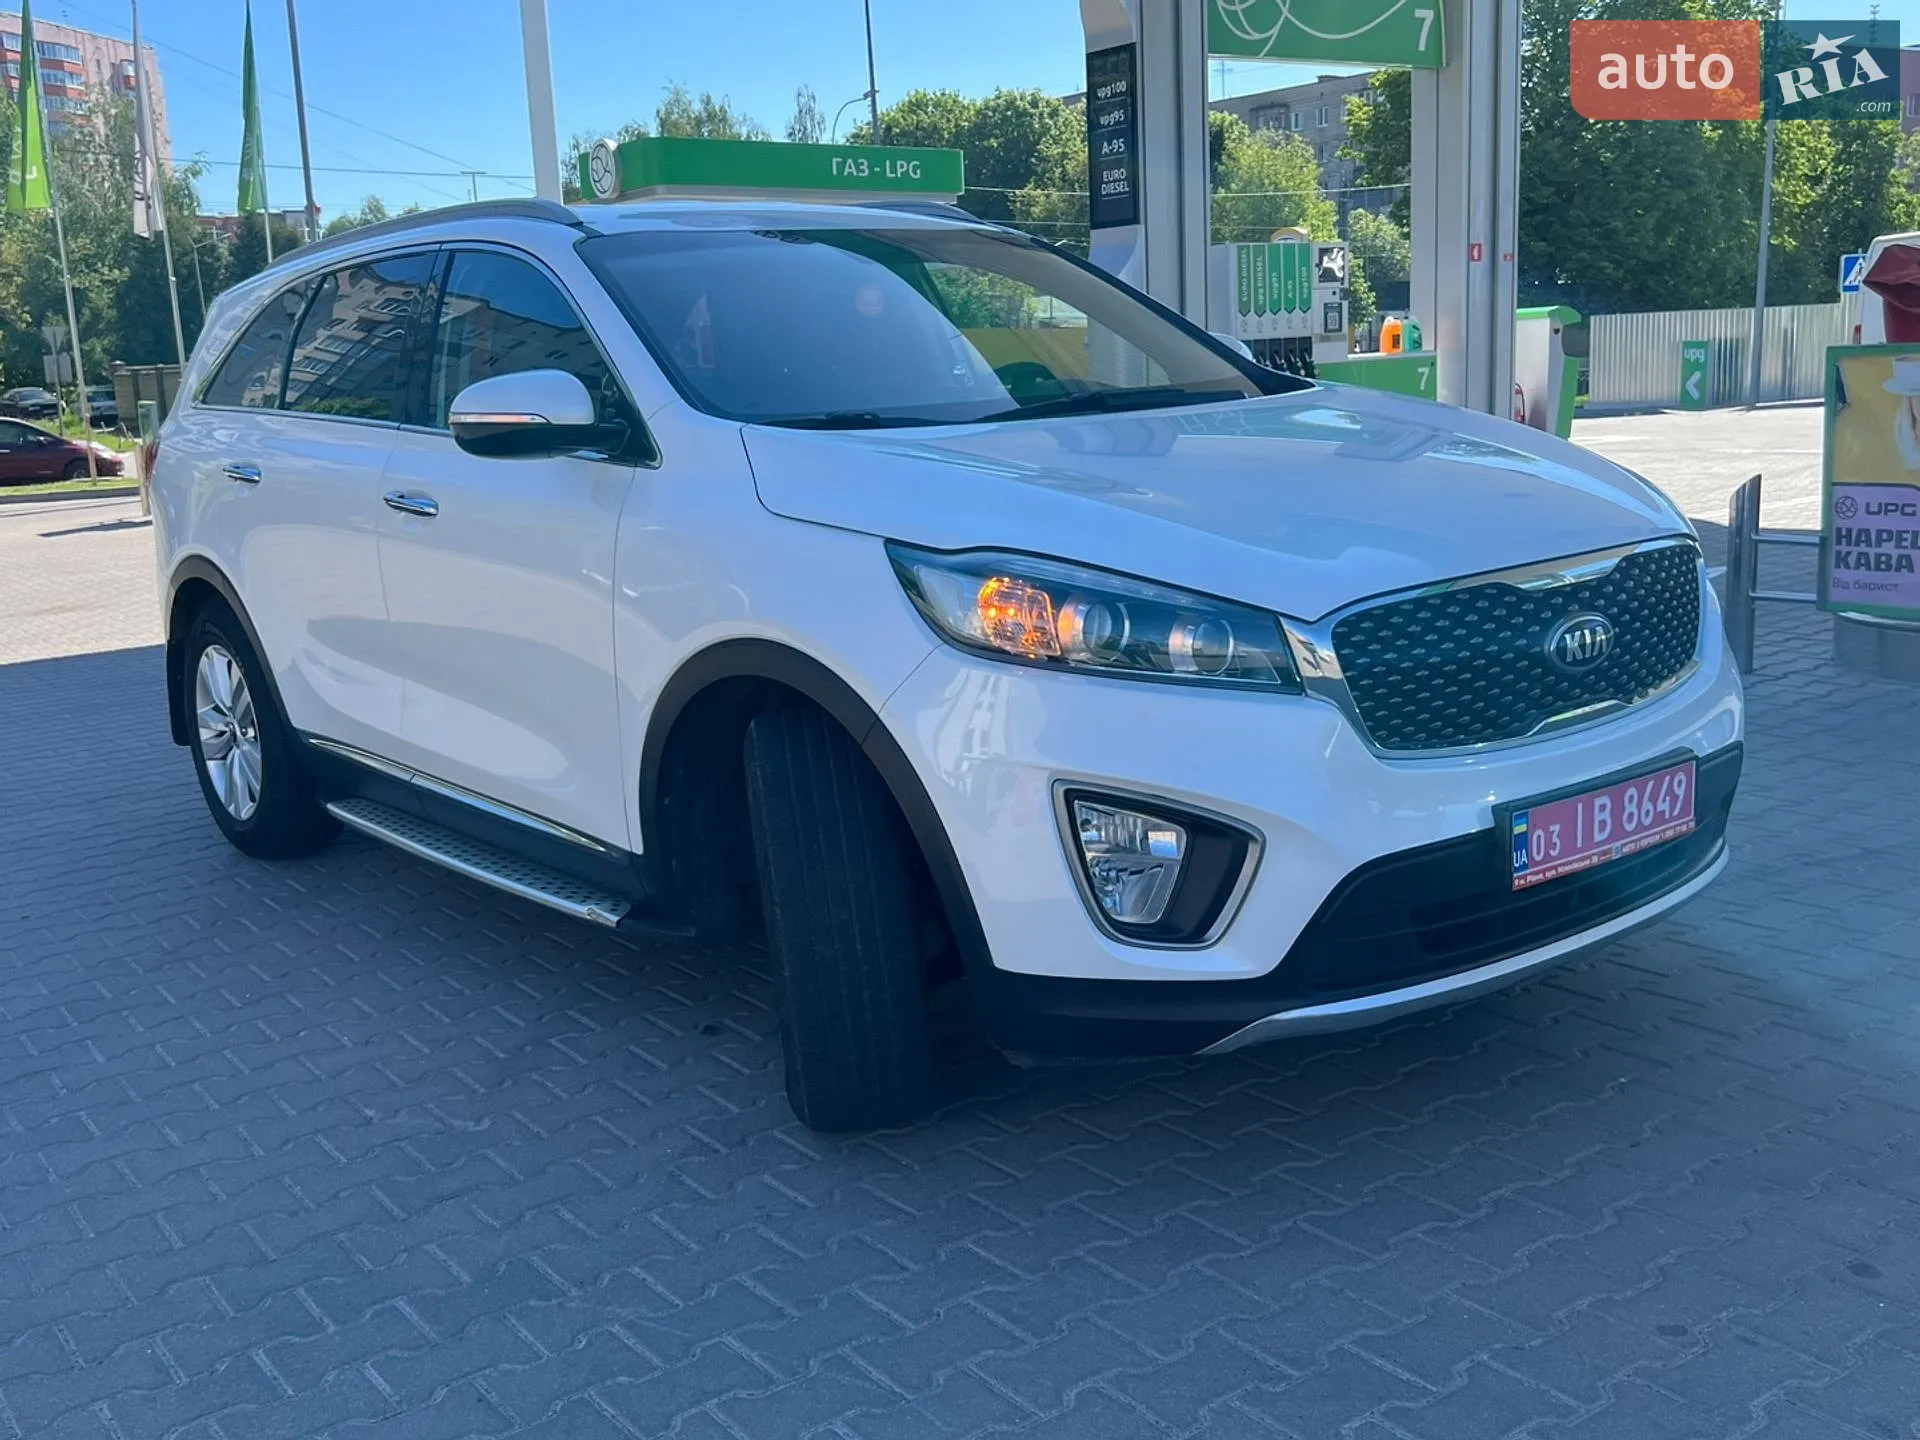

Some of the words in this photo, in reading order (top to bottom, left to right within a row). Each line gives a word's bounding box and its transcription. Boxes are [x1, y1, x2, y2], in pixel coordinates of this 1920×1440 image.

[1414, 8, 1434, 51] 7
[831, 157, 869, 176] ГАЗ
[885, 159, 922, 179] LPG
[1102, 167, 1126, 182] EURO
[1101, 181, 1129, 195] DIESEL
[1684, 348, 1705, 363] upg
[1417, 367, 1430, 391] 7
[1865, 502, 1917, 517] UPG
[1834, 550, 1915, 573] КАВА
[1564, 626, 1607, 662] KIA
[1532, 823, 1561, 861] 03
[1623, 771, 1687, 832] 8649
[1513, 848, 1528, 867] UA
